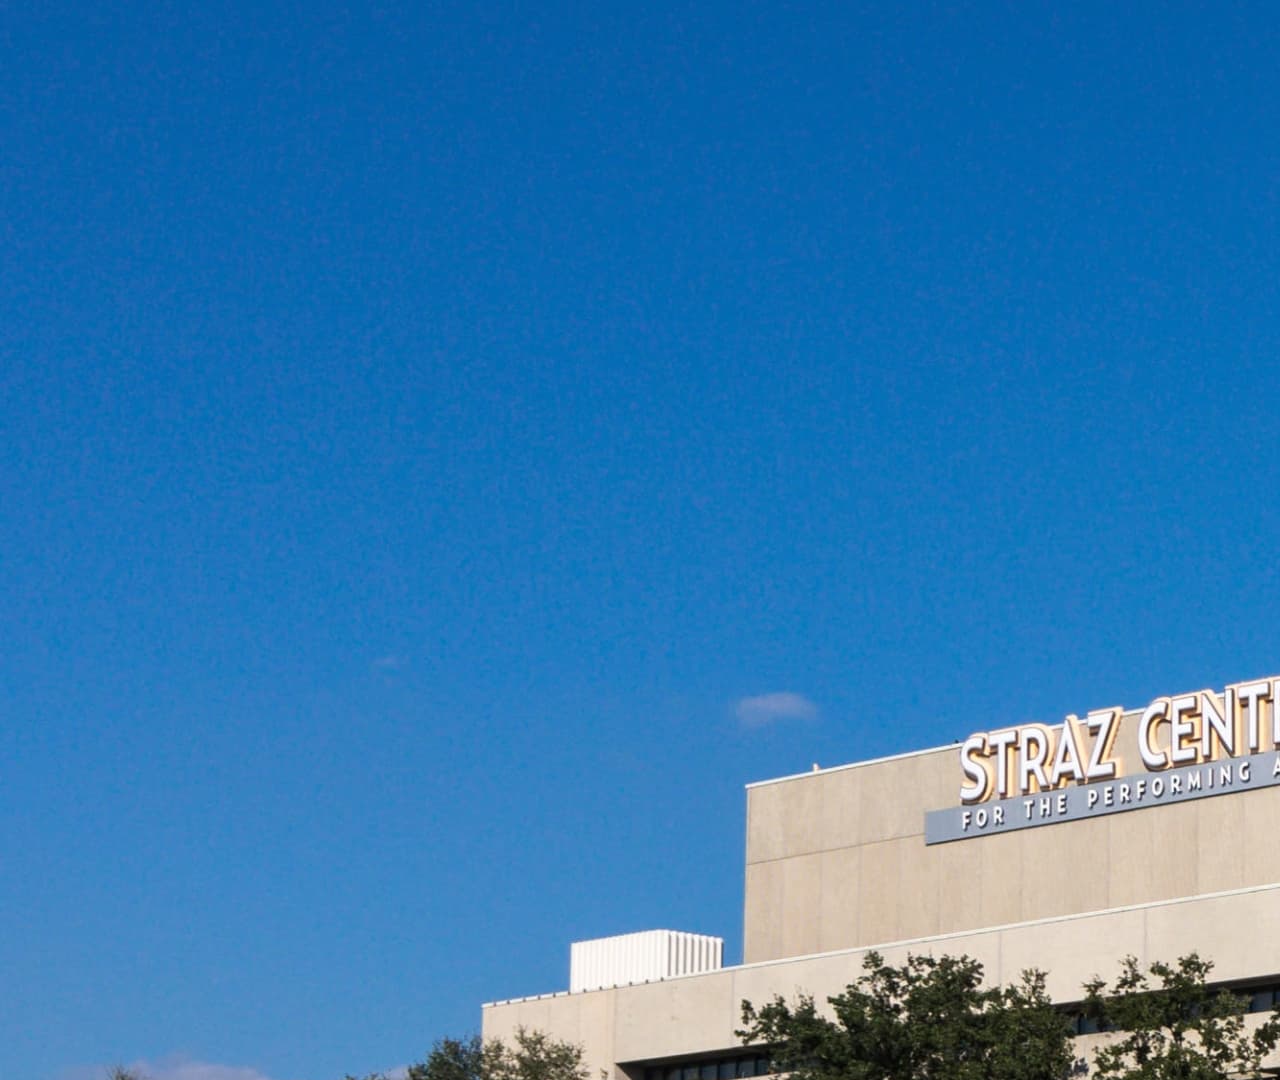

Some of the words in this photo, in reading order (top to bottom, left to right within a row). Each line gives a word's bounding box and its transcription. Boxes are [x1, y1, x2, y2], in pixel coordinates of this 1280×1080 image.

[960, 709, 1119, 805] STRAZ
[962, 805, 1005, 831] FOR
[1024, 794, 1068, 819] THE
[1088, 761, 1251, 809] PERFORMING
